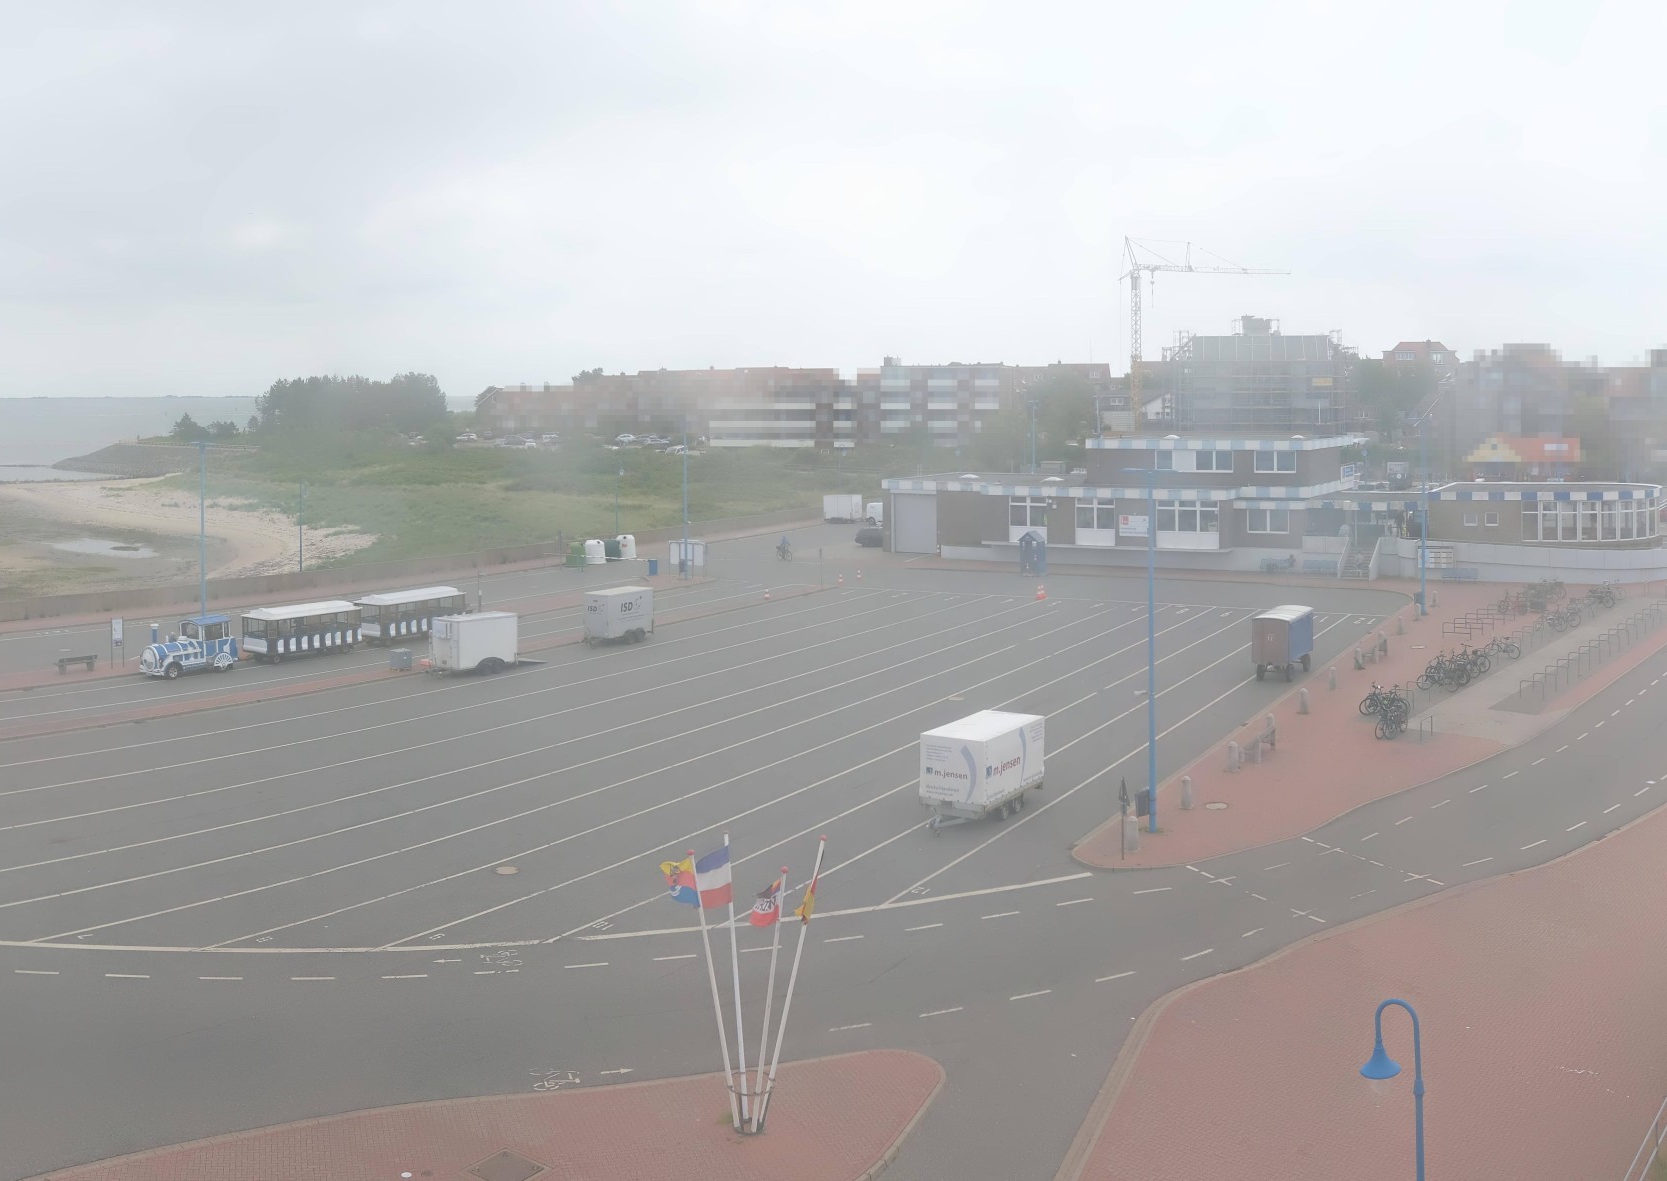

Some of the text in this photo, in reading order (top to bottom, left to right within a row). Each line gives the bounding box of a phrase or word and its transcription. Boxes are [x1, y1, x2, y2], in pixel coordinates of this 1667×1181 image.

[620, 602, 634, 613] ISD
[993, 756, 1021, 776] m.jensen
[934, 769, 968, 780] m.jensen
